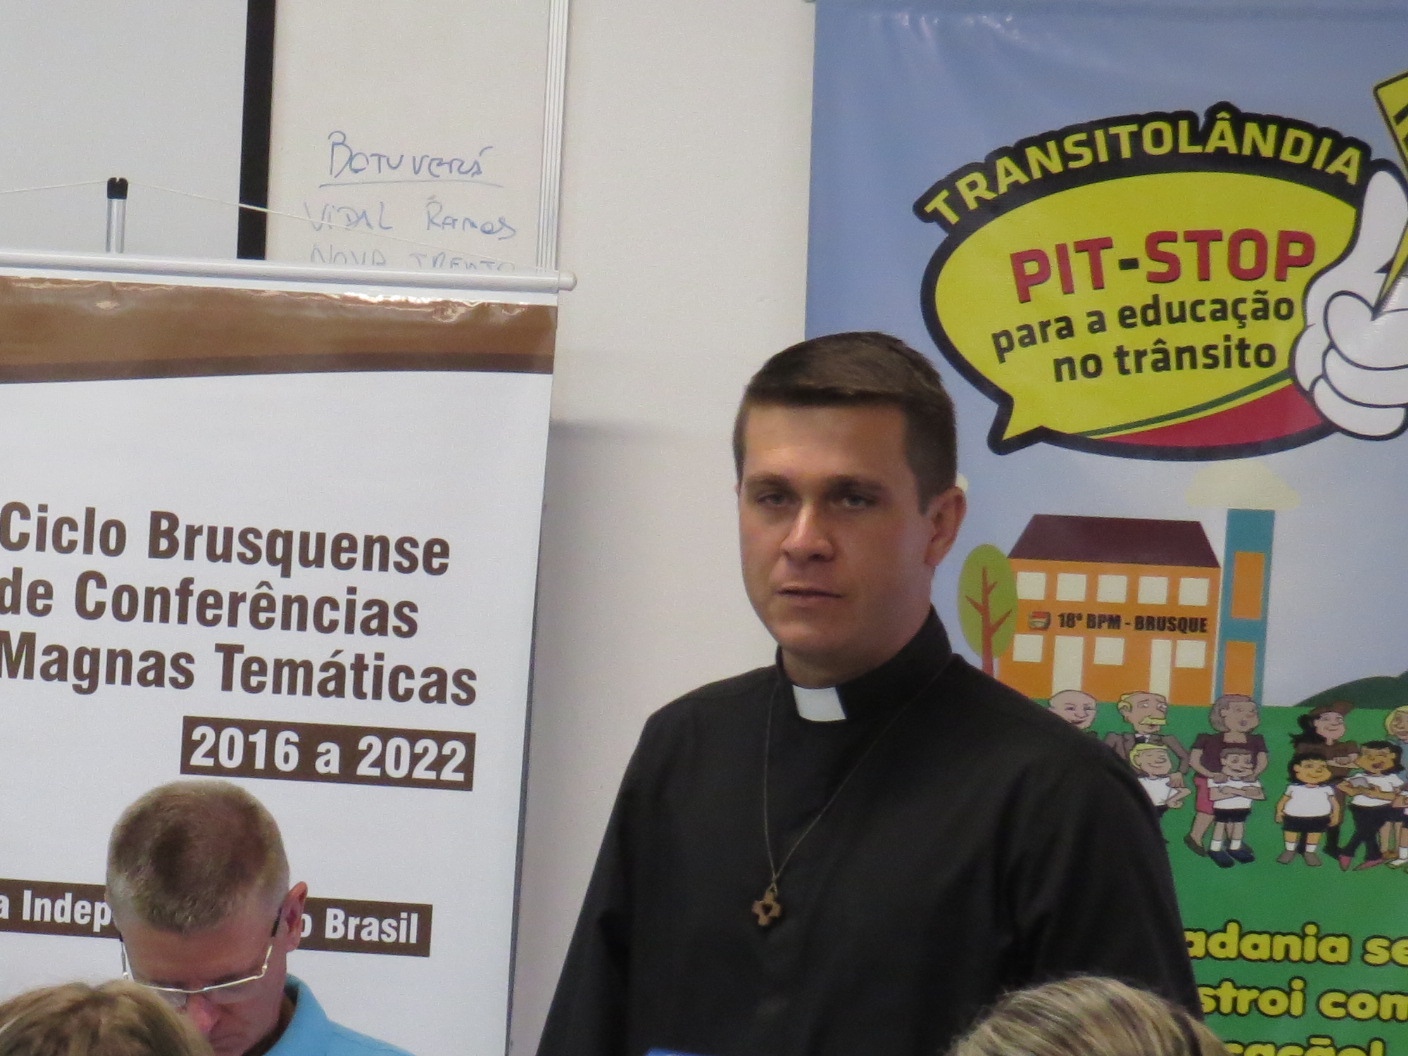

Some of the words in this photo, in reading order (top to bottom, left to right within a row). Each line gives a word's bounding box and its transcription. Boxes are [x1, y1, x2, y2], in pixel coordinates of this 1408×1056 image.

[924, 110, 1365, 227] TRANSITOLÂNDIA
[1010, 228, 1317, 304] PIT-STOP
[992, 314, 1075, 363] para
[1086, 308, 1107, 334] a
[1118, 290, 1295, 329] educação
[1053, 350, 1103, 382] no
[1114, 335, 1277, 377] trânsito
[148, 510, 450, 577] Brusquense
[75, 570, 420, 639] Conferências
[1086, 613, 1122, 630] BPM
[1134, 615, 1208, 635] BRUSQUE
[215, 643, 477, 706] Temáticas
[189, 726, 300, 772] 2016
[315, 740, 341, 774] a
[356, 736, 467, 782] 2022
[325, 907, 419, 944] Brasil
